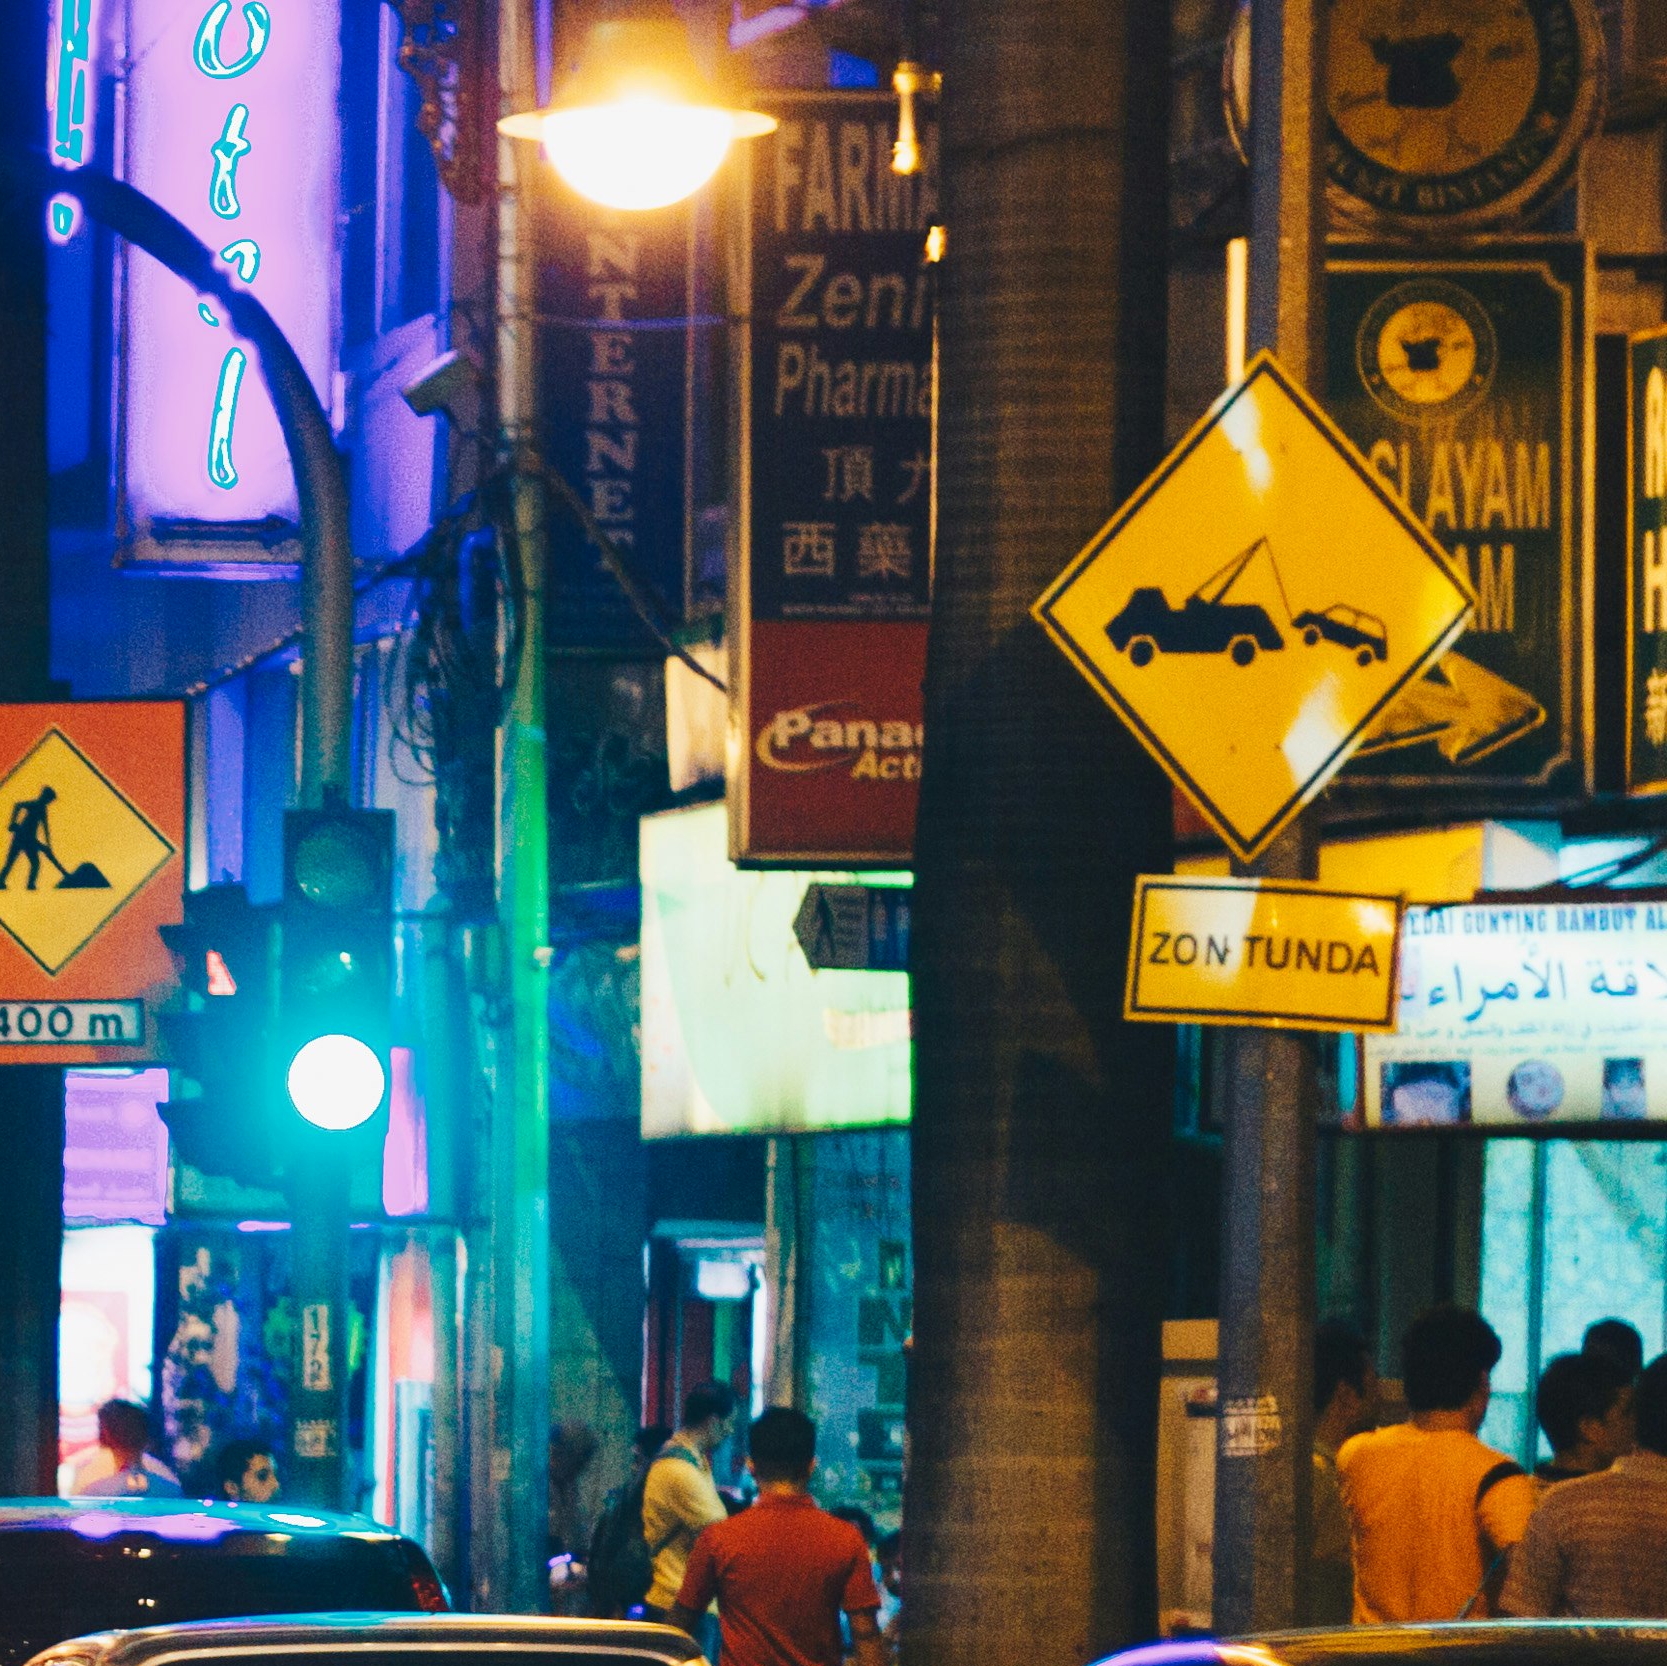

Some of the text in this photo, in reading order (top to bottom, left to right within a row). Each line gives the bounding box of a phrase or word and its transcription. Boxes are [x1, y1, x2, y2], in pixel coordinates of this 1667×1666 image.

[1463, 909, 1547, 936] GUNTING
[1556, 906, 1637, 934] RAMBUT
[1149, 932, 1382, 977] ZON TUNDA
[88, 1011, 124, 1039] m
